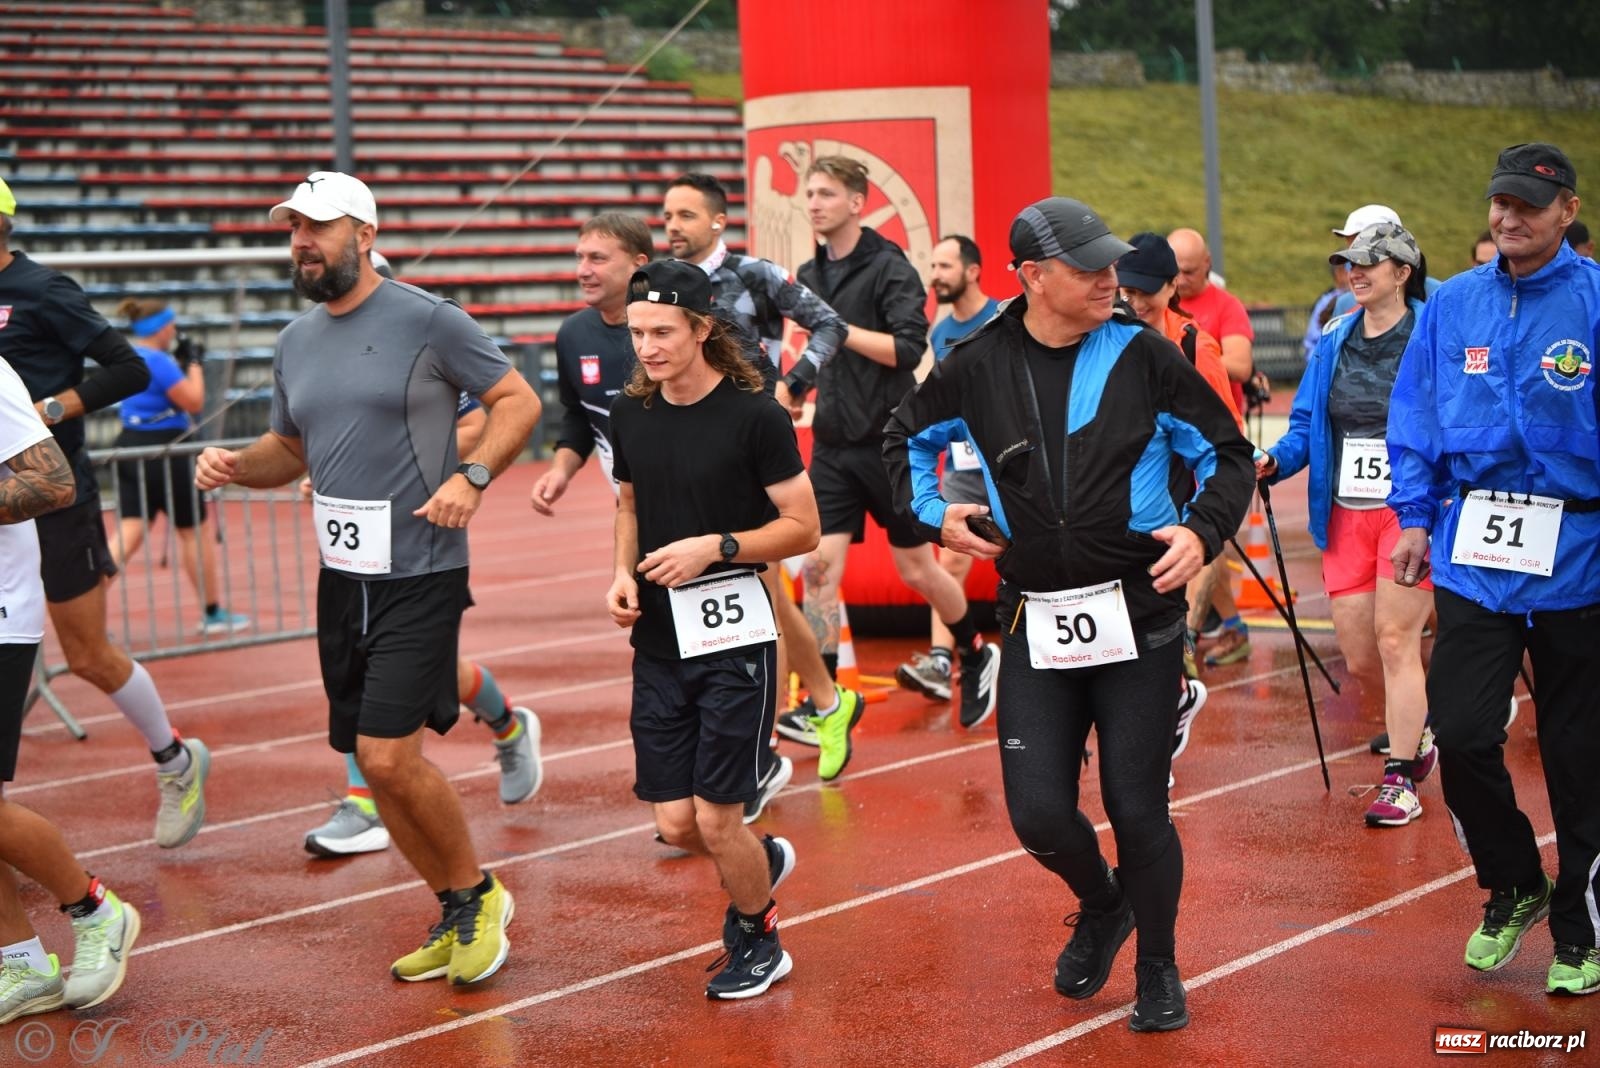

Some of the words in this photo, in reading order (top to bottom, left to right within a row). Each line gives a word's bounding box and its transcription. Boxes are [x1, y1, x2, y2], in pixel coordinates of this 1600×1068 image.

[327, 519, 360, 551] 93
[1482, 514, 1524, 548] 51
[1472, 551, 1511, 565] Racibórz
[1520, 558, 1541, 569] OSiR
[700, 592, 744, 629] 85
[702, 635, 740, 648] Racibórz
[1054, 612, 1098, 646] 50
[1051, 654, 1093, 664] Racibórz
[1102, 647, 1124, 658] OSiR
